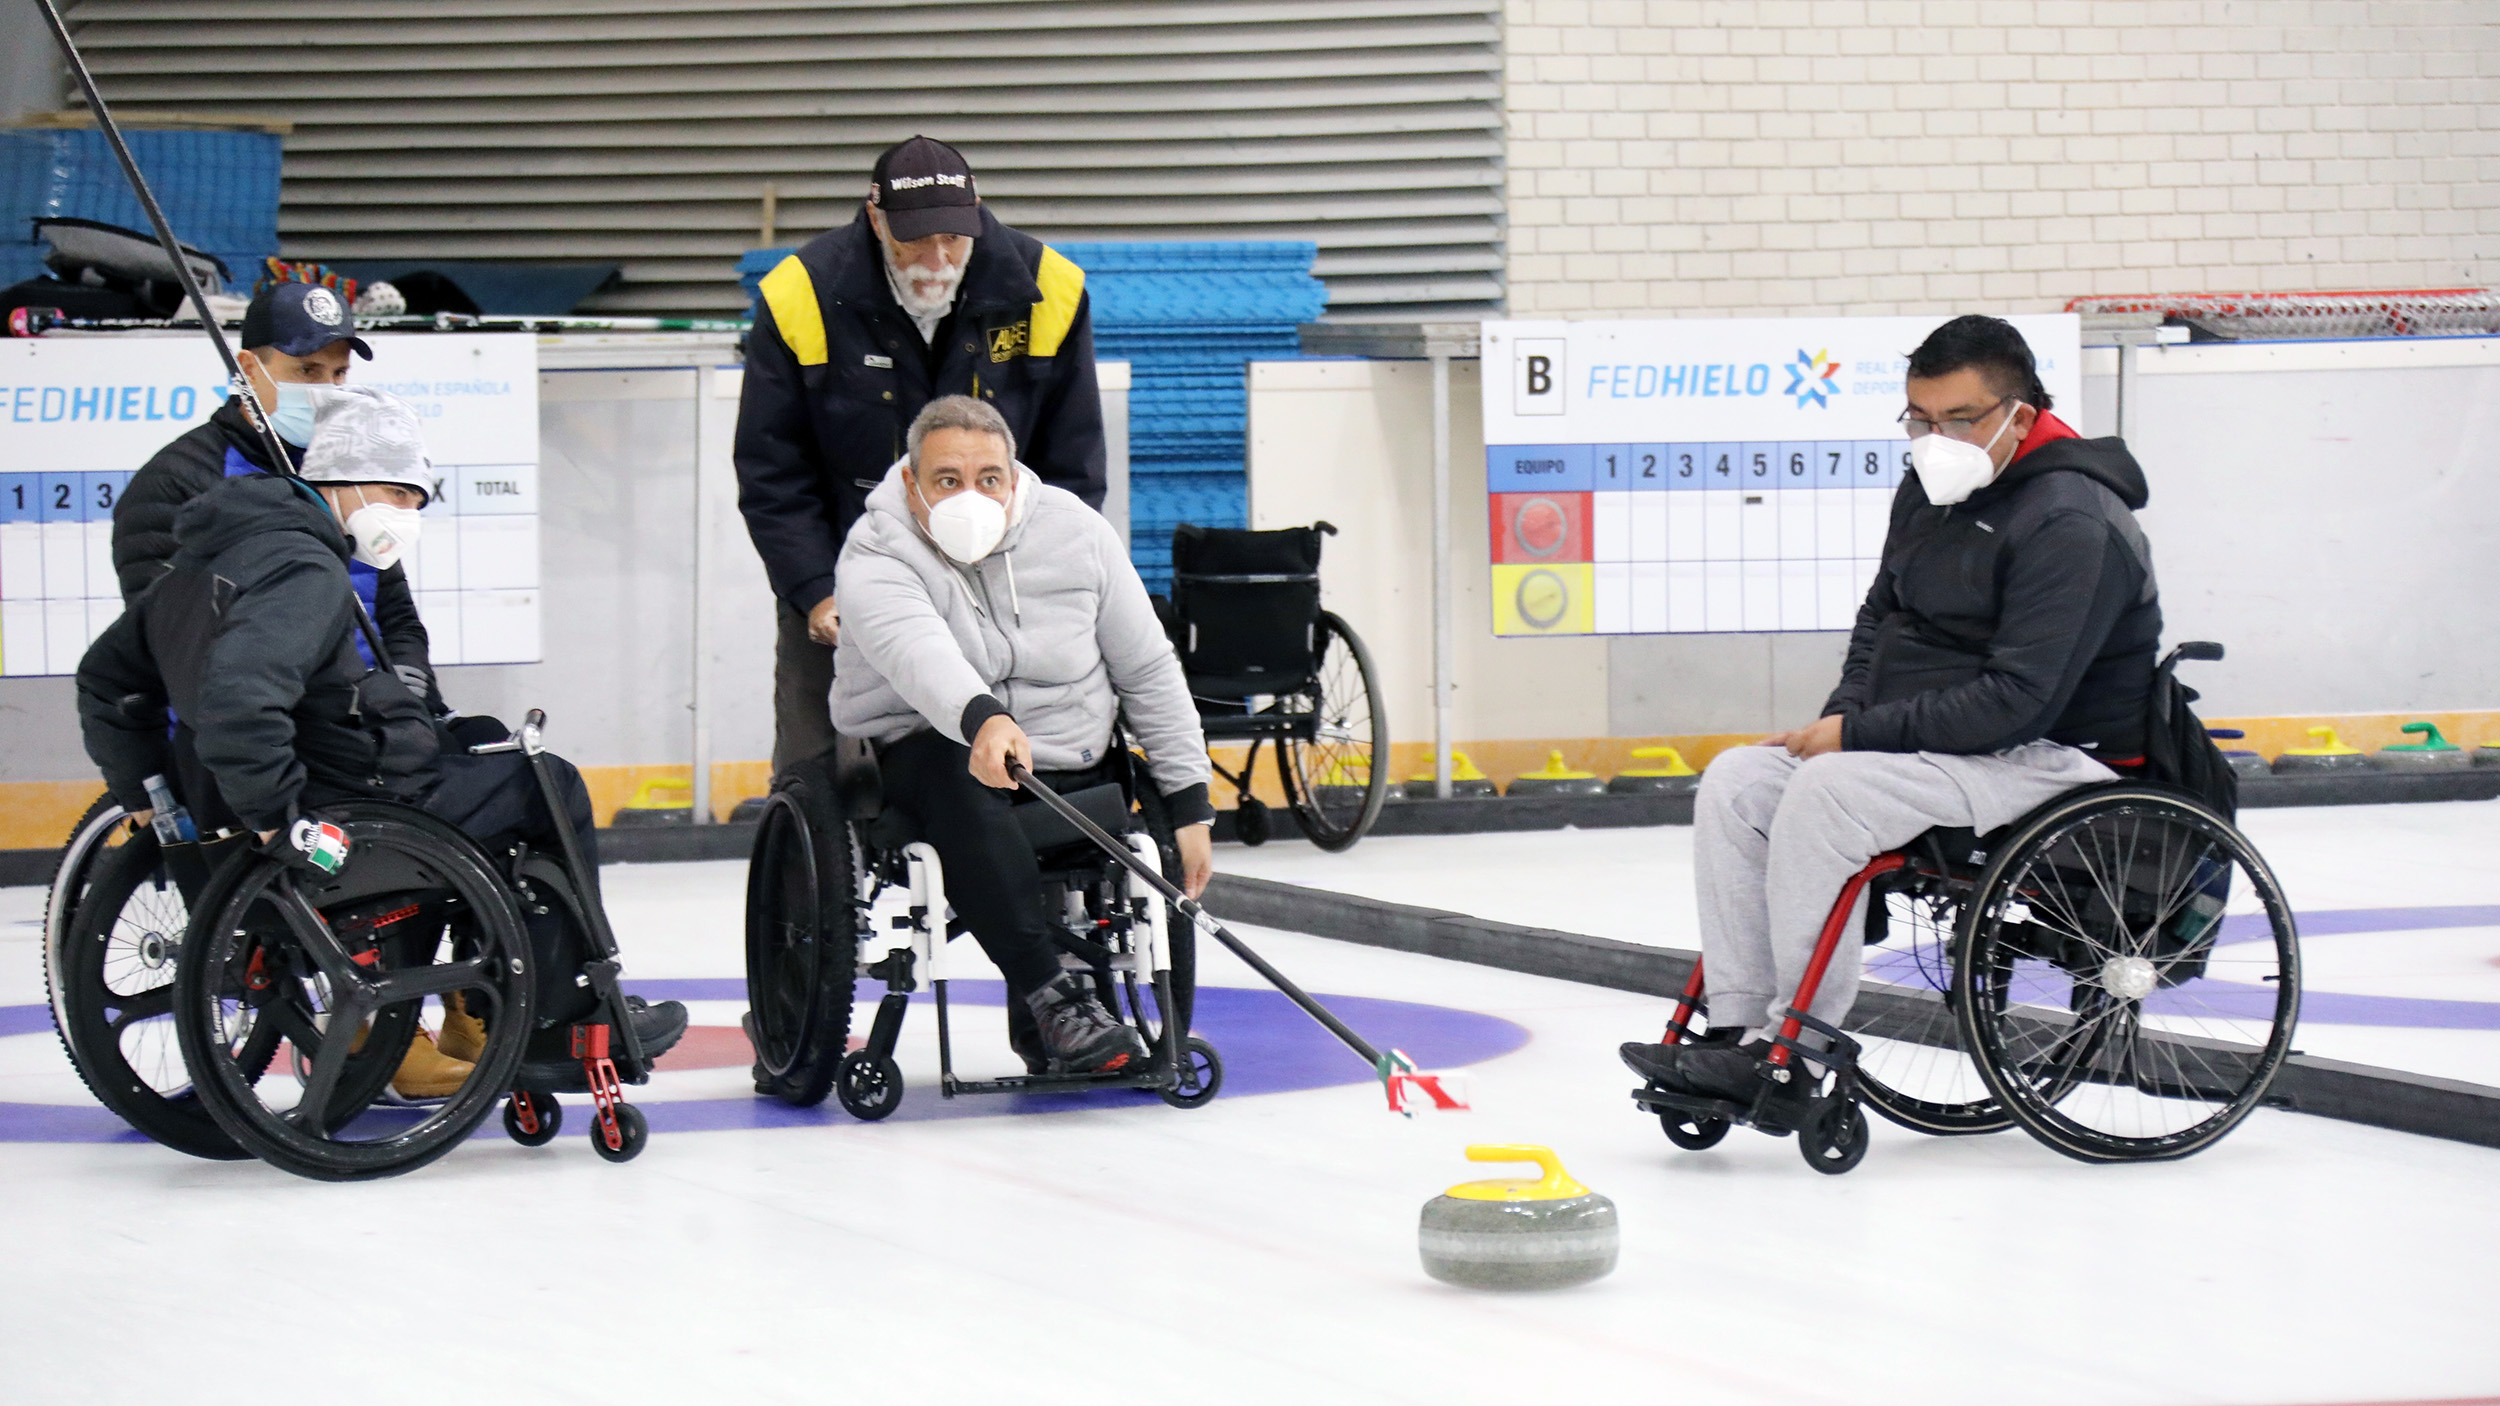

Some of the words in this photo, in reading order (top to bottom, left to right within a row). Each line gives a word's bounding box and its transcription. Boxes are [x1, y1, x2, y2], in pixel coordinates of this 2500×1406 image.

[890, 176, 934, 191] Wilson
[936, 173, 967, 189] Staff
[1527, 355, 1552, 396] B
[1856, 361, 1889, 374] REAL
[434, 379, 511, 395] ESPAÑOLA
[1588, 363, 1771, 399] FEDHIELO
[1515, 460, 1565, 474] EQUIPO
[1606, 454, 1616, 478] 1
[1642, 454, 1657, 478] 2
[1679, 454, 1693, 477] 3
[1716, 453, 1730, 477] 4
[1753, 453, 1767, 477] 5
[1790, 453, 1804, 476] 6
[1827, 452, 1841, 475] 7
[1864, 452, 1878, 475] 8
[12, 484, 24, 509] 1
[54, 484, 71, 509] 2
[97, 484, 113, 508] 3
[475, 481, 520, 495] TOTAL
